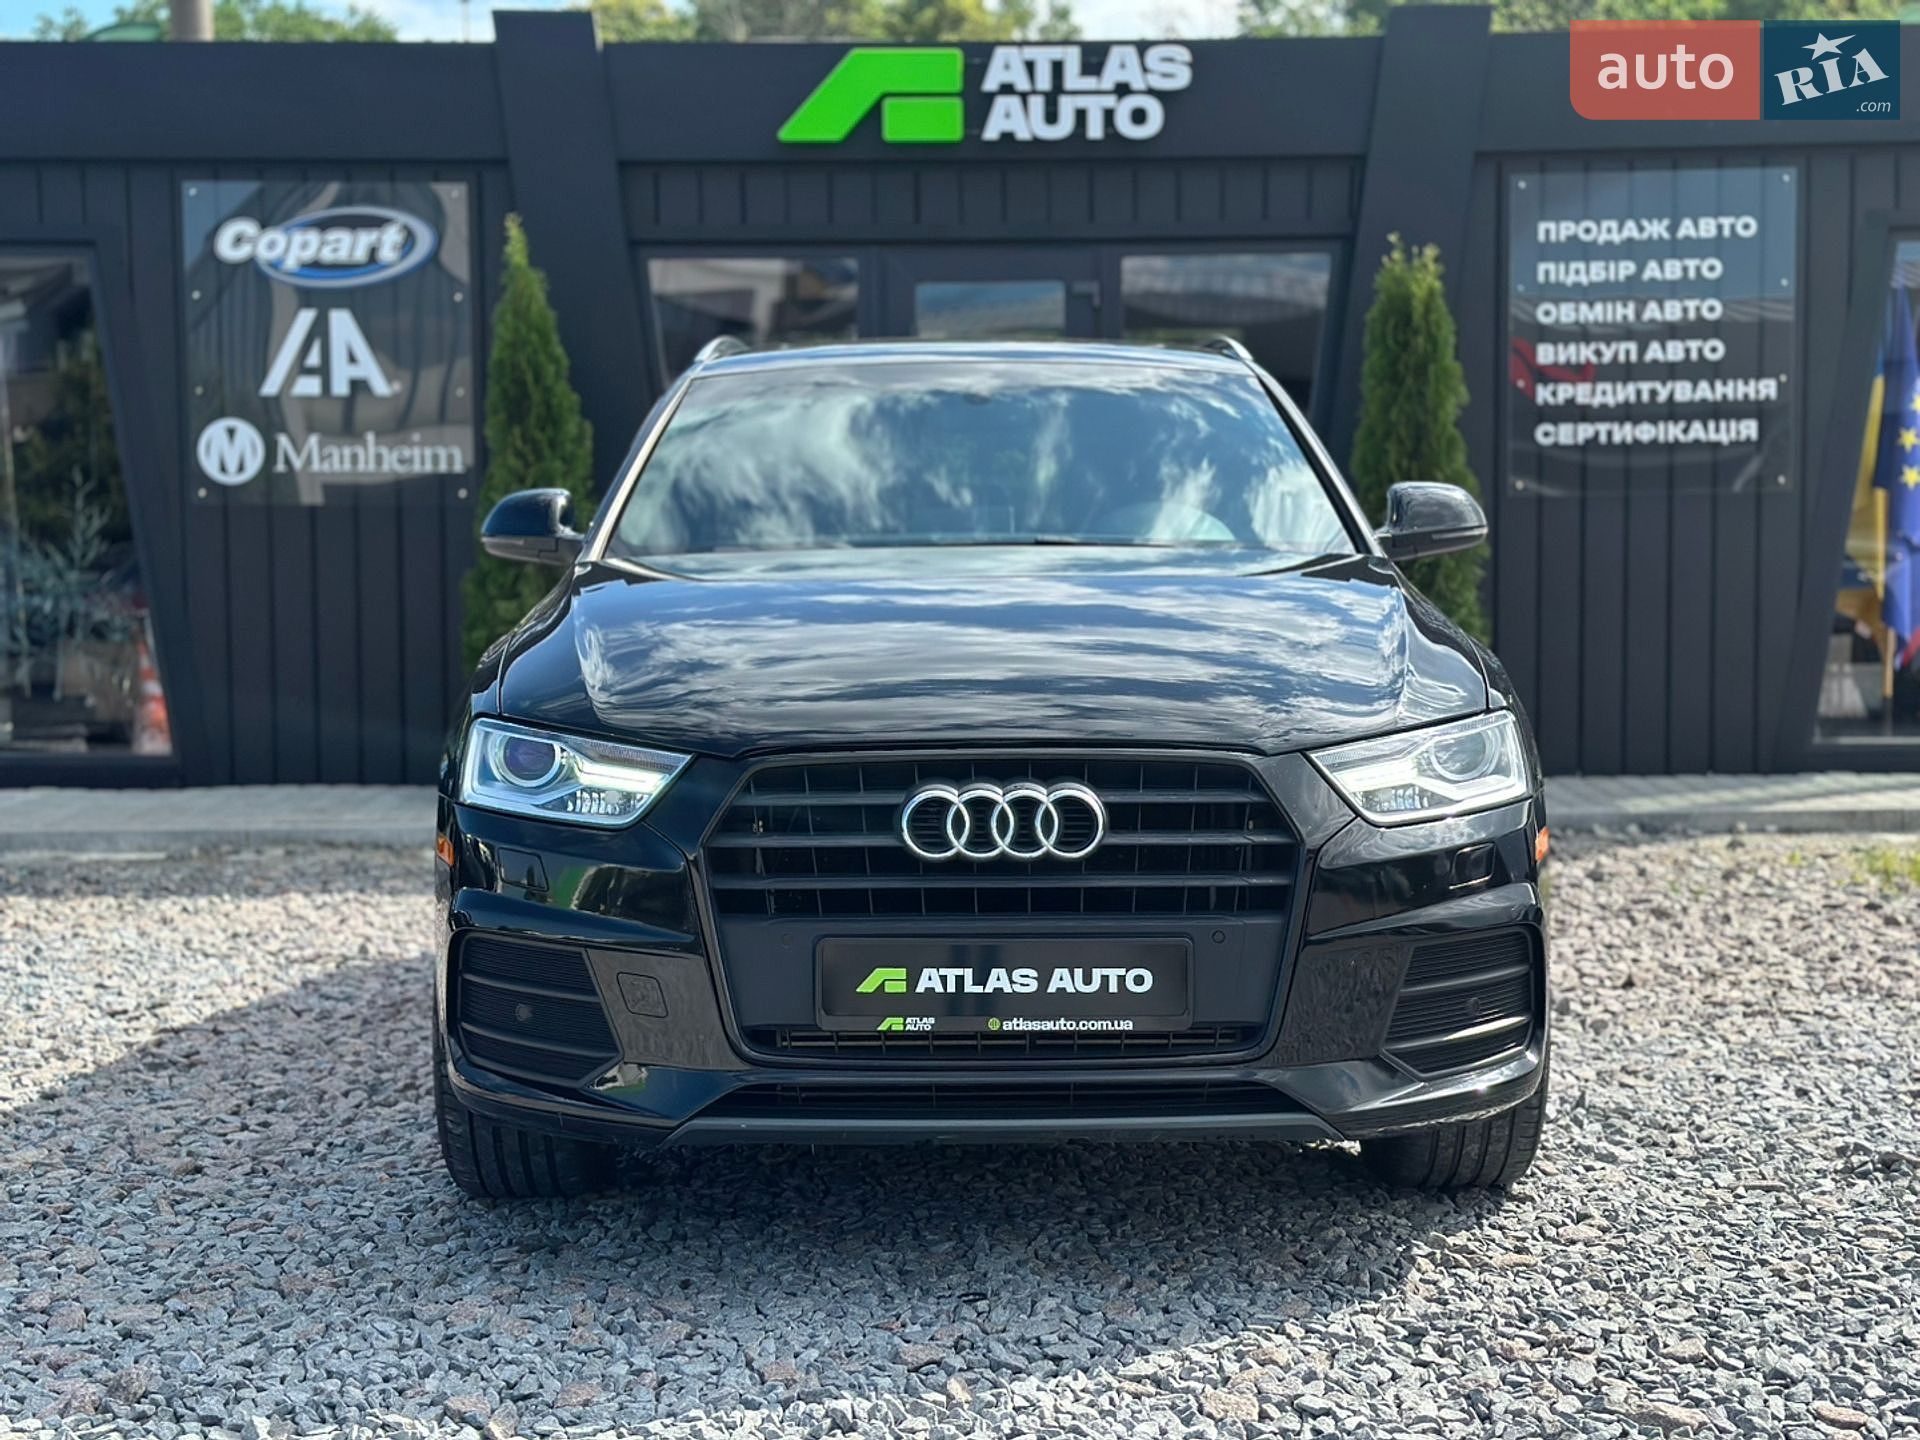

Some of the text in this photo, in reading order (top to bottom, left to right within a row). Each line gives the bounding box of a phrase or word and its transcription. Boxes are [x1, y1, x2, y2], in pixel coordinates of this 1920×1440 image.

[980, 44, 1193, 93] ATLAS
[980, 93, 1165, 141] AUTO
[214, 216, 407, 272] Copart
[1536, 215, 1759, 245] ПРОДАЖ АВТО
[1536, 257, 1724, 286] ПІДБІР АВТО
[1535, 298, 1724, 325] ОБМІН АВТО
[1535, 338, 1726, 366] ВИКУП АВТО
[1534, 377, 1778, 407] КРЕДИТУВАННЯ
[1534, 418, 1759, 446] СЕРТИФІКАЦІЯ
[273, 430, 466, 474] Manheim
[914, 967, 1153, 994] ATLAS AUTO
[905, 1017, 935, 1025] ATLAS
[1002, 1017, 1134, 1032] atlasauto.com.ua
